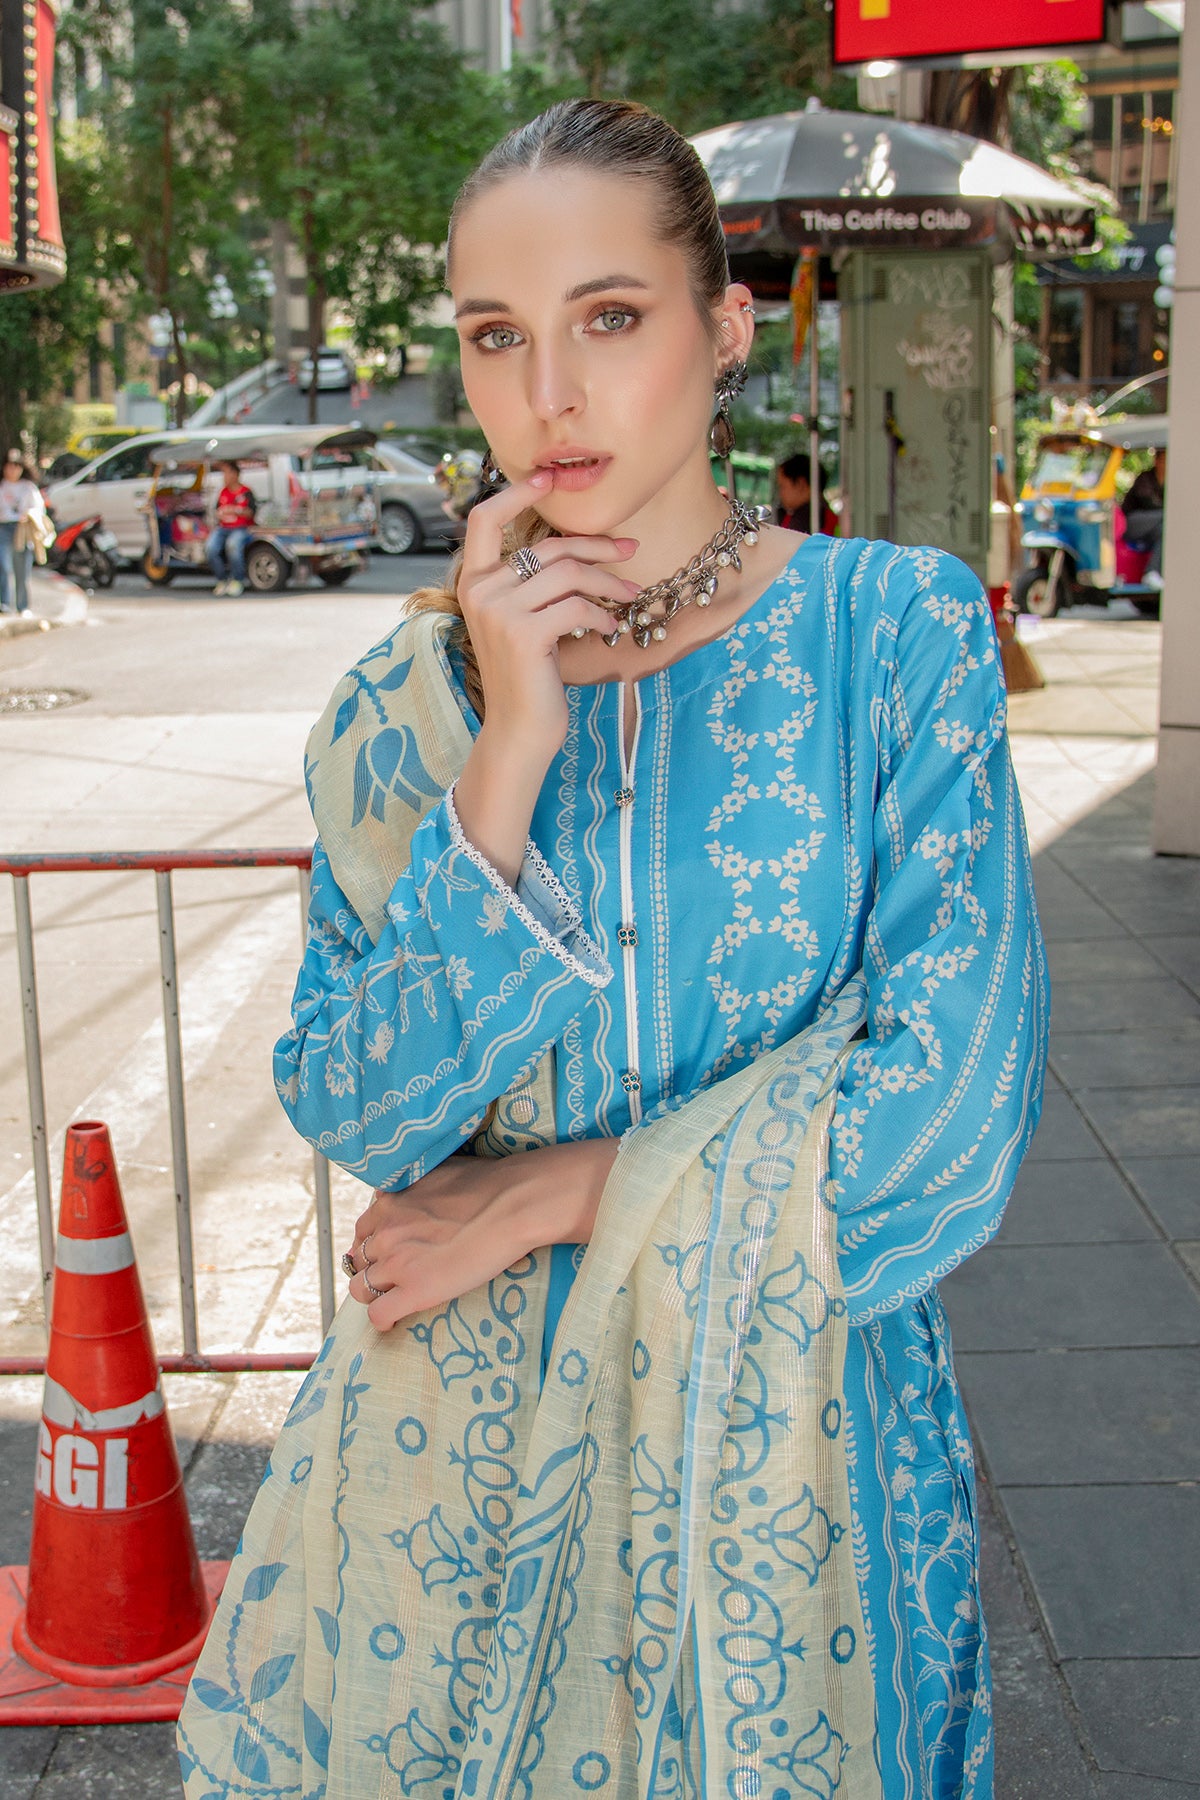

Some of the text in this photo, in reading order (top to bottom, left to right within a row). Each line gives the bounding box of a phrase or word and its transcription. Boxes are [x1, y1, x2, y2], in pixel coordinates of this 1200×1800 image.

[801, 207, 971, 231] The Coffee Club
